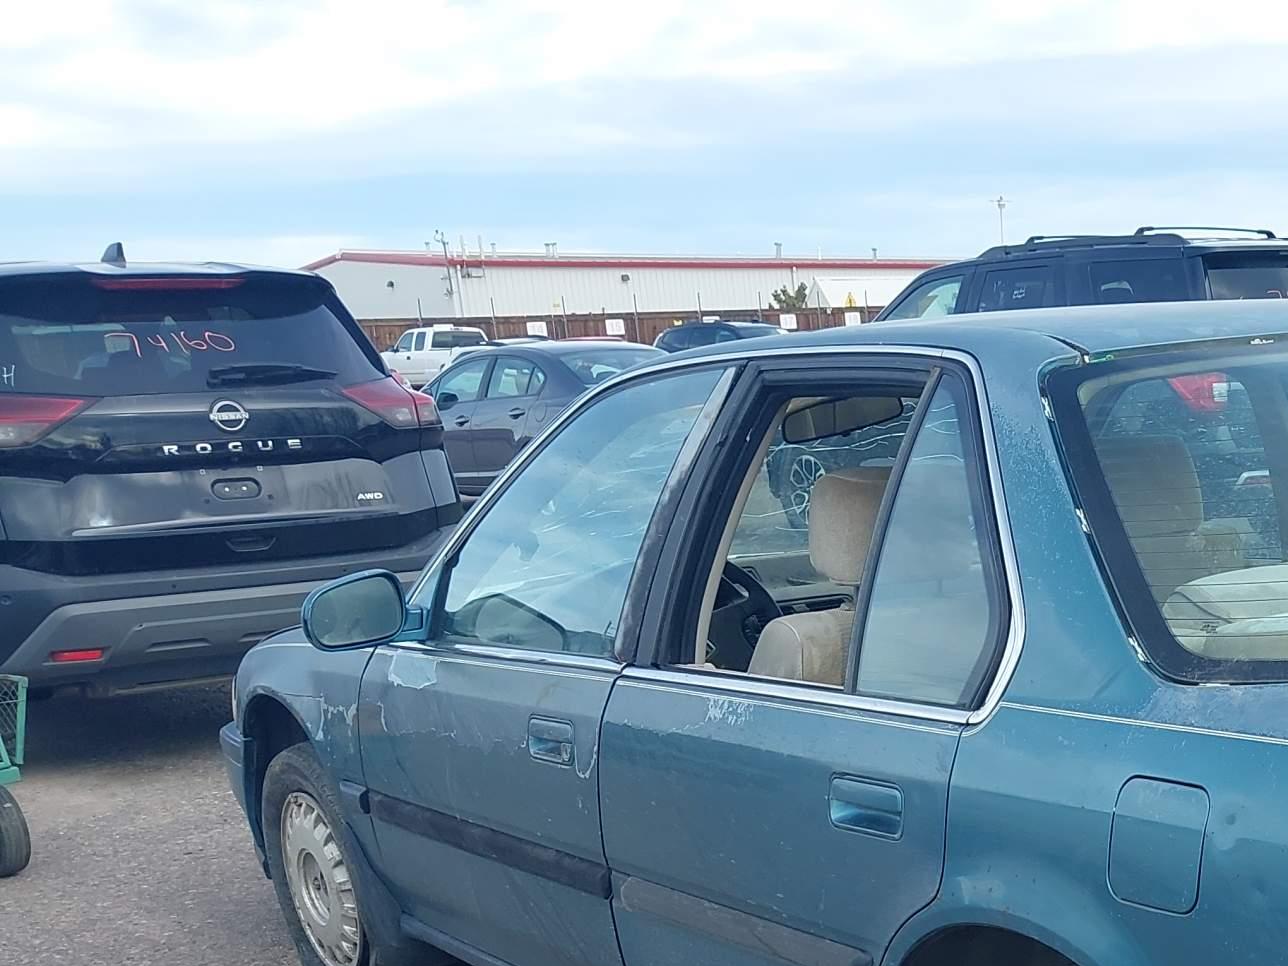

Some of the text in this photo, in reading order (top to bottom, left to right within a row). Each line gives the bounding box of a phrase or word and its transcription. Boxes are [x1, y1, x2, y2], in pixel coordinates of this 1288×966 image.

[209, 412, 249, 421] NISSAN
[162, 438, 302, 456] ROGUE
[357, 492, 384, 501] AWD
